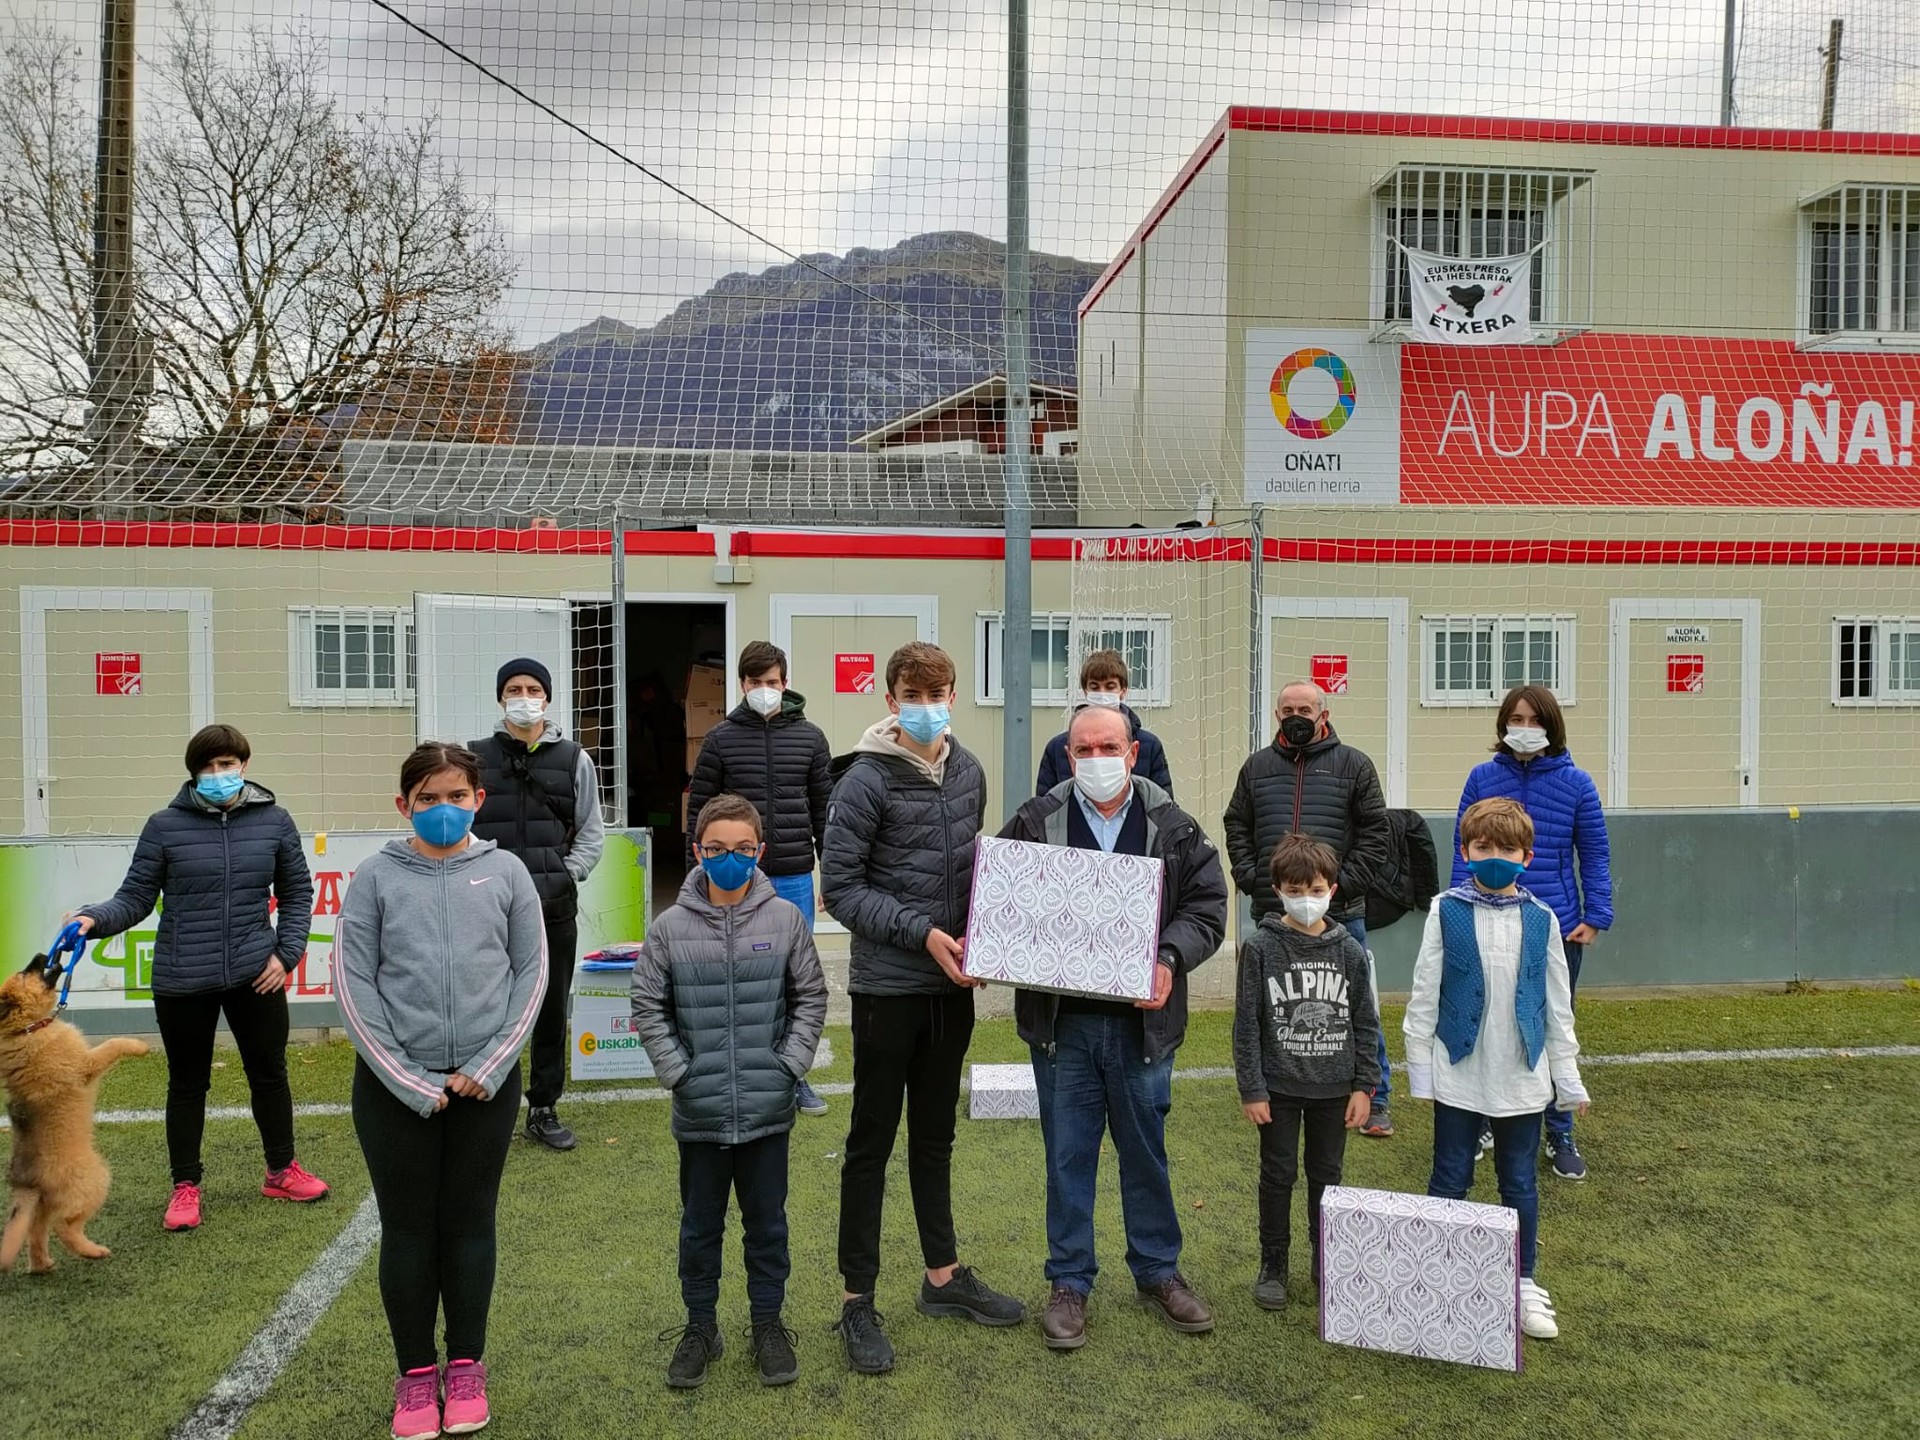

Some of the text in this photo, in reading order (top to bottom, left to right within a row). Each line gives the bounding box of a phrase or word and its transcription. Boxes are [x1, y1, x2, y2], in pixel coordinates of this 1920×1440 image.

[1427, 264, 1509, 275] EUSKAL PRESO
[1424, 272, 1513, 283] ETA IHESLARIAK
[1429, 313, 1516, 334] ETXERA
[1437, 382, 1913, 467] AUPA ALOÑA!
[1285, 450, 1341, 471] OÑATI
[1265, 478, 1360, 493] dabilen herria
[1290, 962, 1338, 970] ORIGINAL
[1275, 1007, 1284, 1016] 19
[1277, 1026, 1313, 1041] Mount
[1283, 1042, 1305, 1051] TOUGH
[1313, 1042, 1344, 1051] DURABLE
